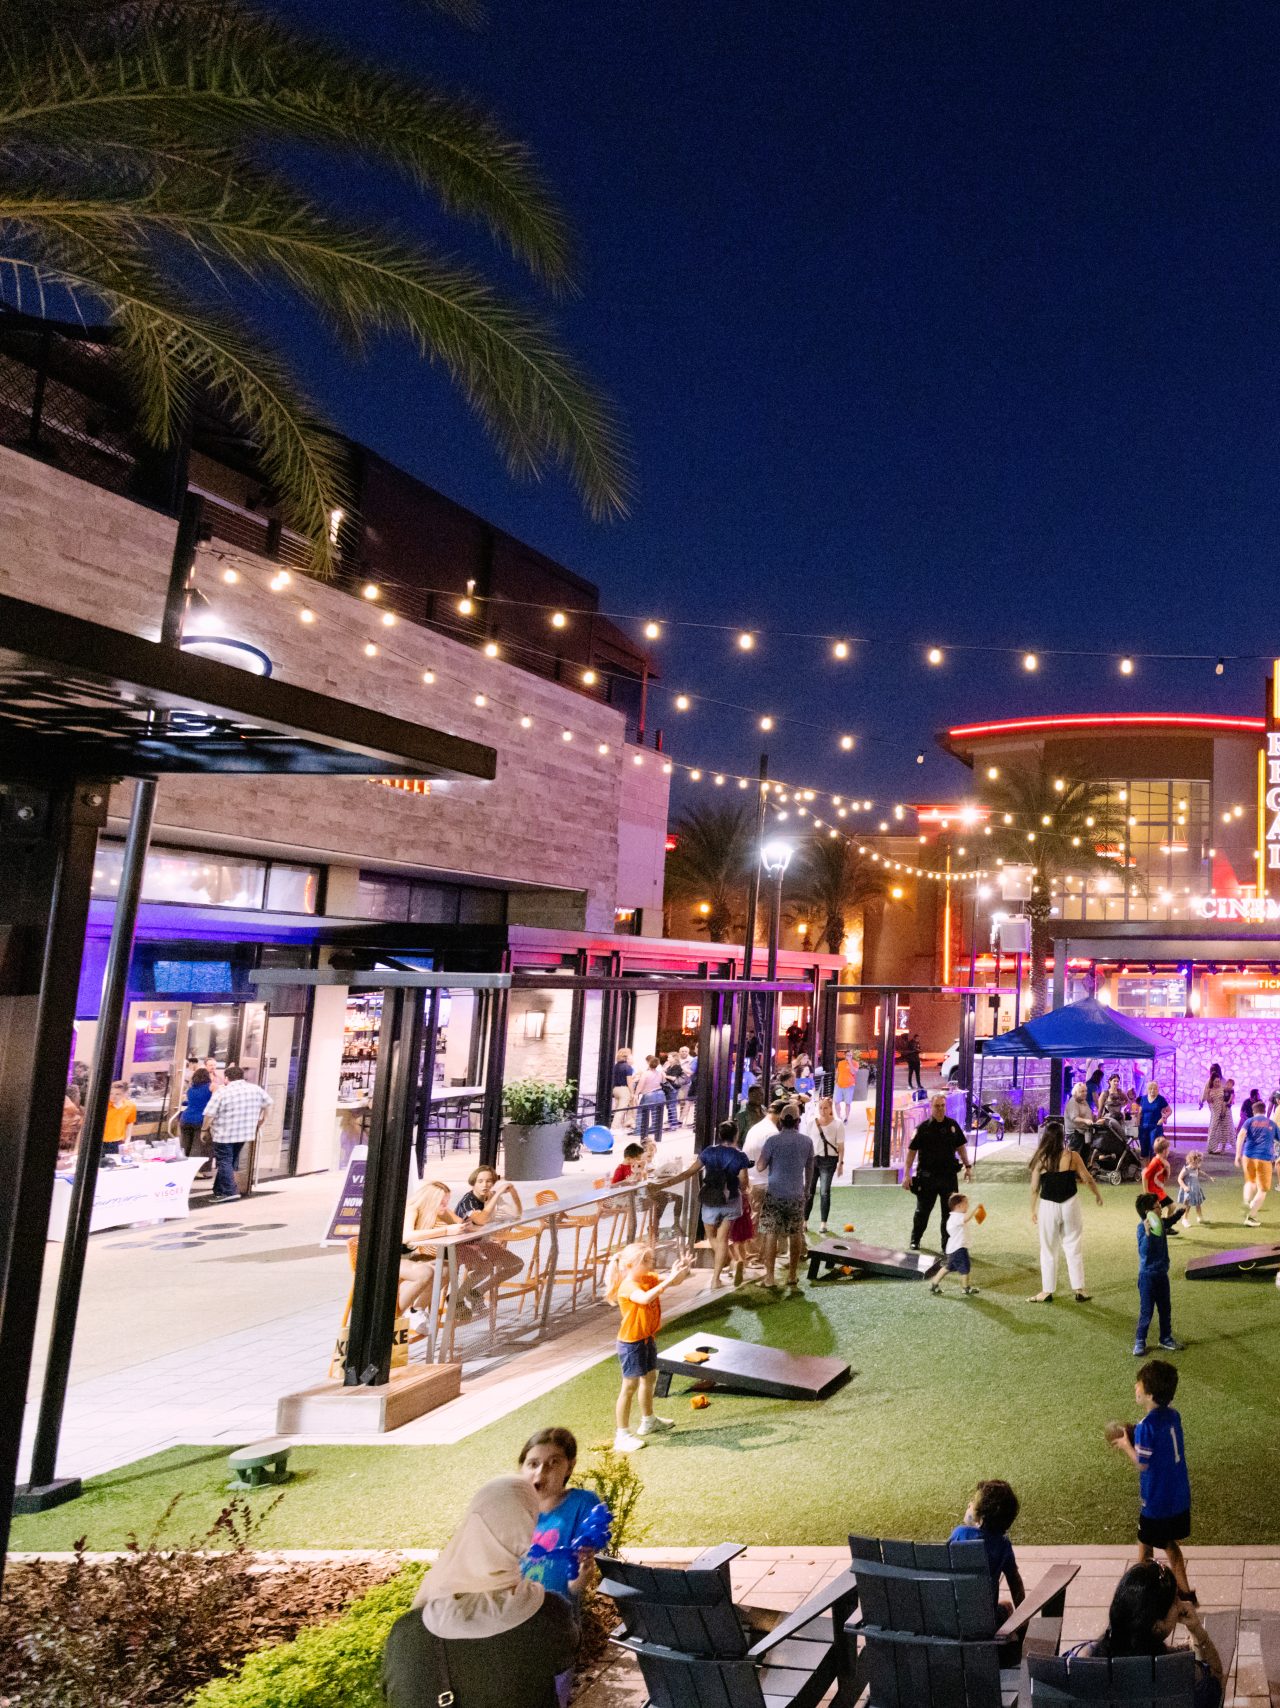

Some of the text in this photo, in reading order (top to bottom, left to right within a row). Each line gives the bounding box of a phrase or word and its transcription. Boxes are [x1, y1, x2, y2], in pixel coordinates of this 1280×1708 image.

[343, 1198, 363, 1207] NOW
[393, 1329, 409, 1345] KE
[1170, 1427, 1181, 1463] 1
